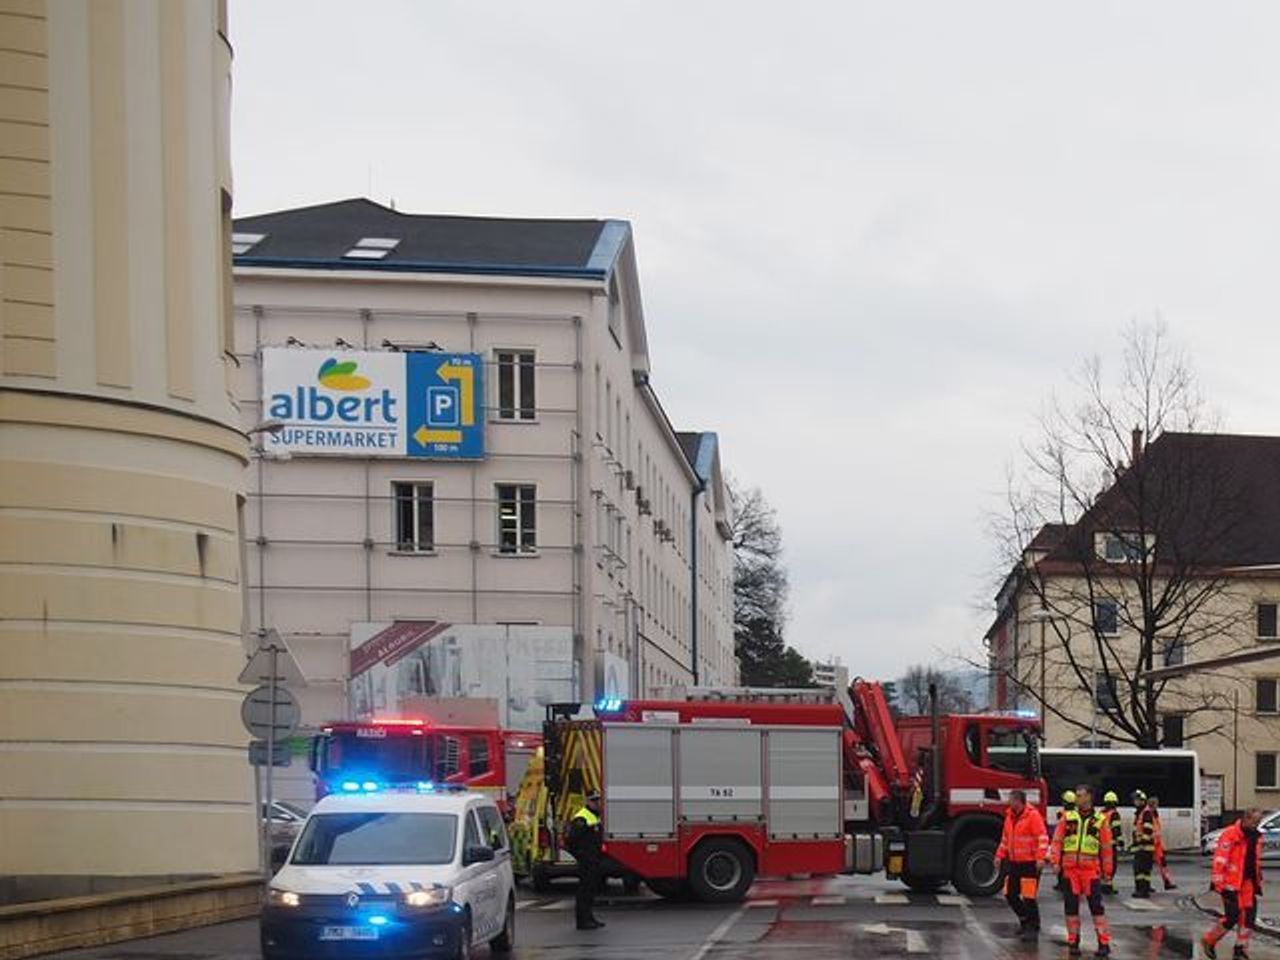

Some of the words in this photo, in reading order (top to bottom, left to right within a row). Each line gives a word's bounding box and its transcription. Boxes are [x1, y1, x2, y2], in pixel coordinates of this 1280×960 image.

[270, 386, 398, 424] albert
[436, 394, 452, 416] P
[271, 429, 398, 449] SUPERMARKET
